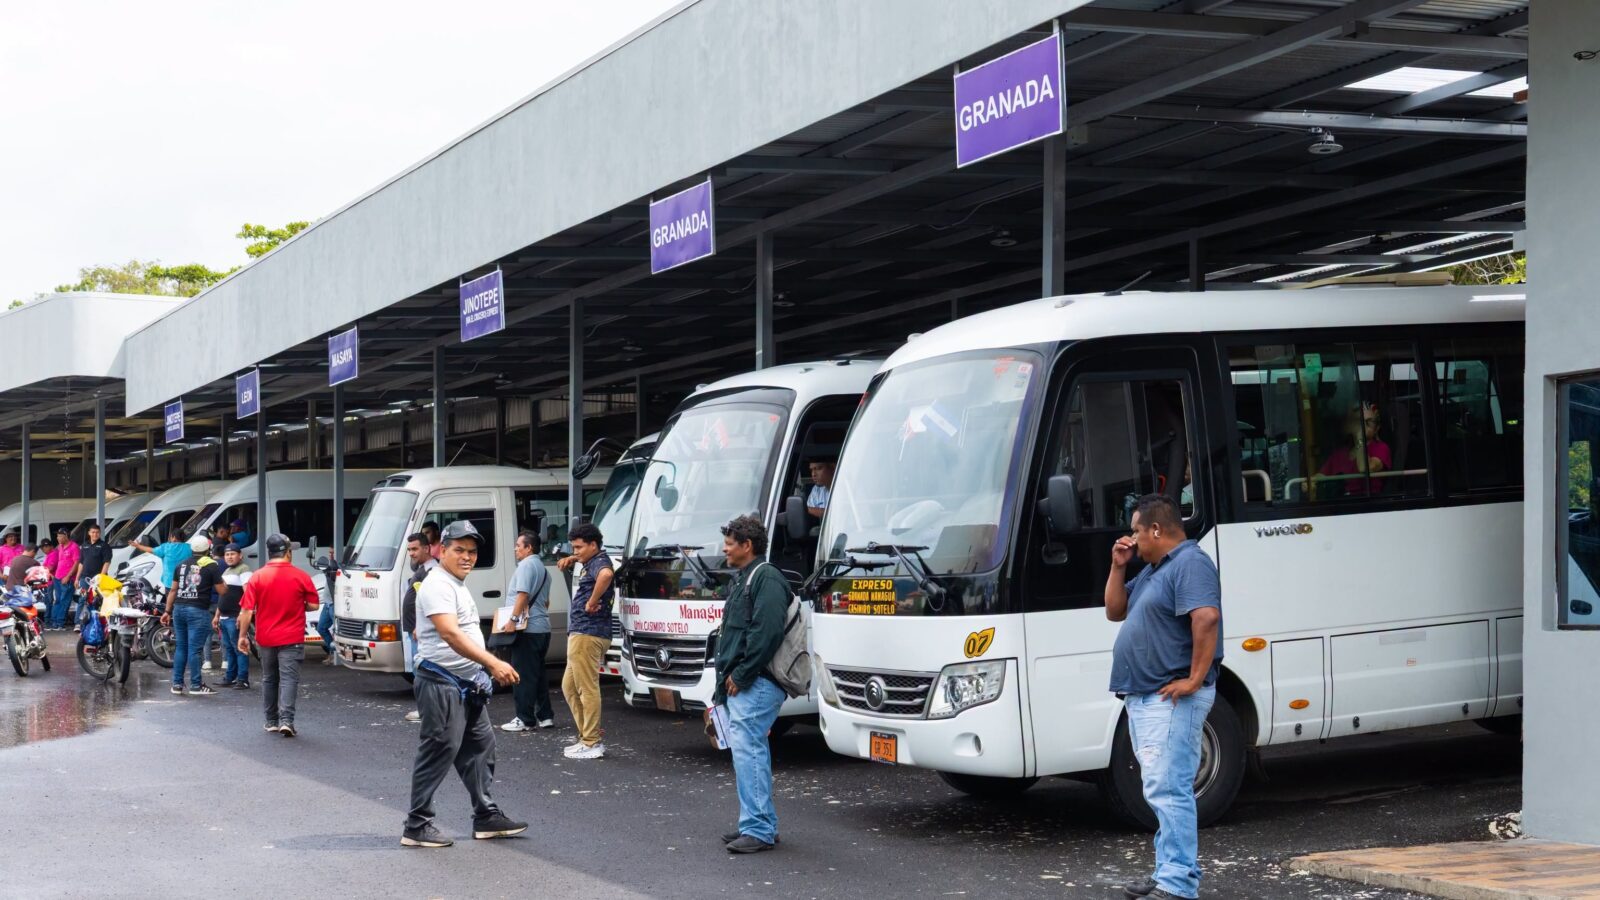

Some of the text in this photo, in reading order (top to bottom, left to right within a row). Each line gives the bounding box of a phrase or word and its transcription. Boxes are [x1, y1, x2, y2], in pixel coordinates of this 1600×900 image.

[959, 74, 1055, 132] GRANADA
[653, 210, 708, 248] GRANADA
[463, 287, 499, 315] JINOTEPE
[331, 347, 353, 368] MASAYA
[852, 579, 893, 590] EXPRESO
[873, 604, 895, 615] SOTELO
[667, 622, 689, 634] SOTELO
[966, 634, 989, 656] 07
[883, 742, 893, 756] 351
